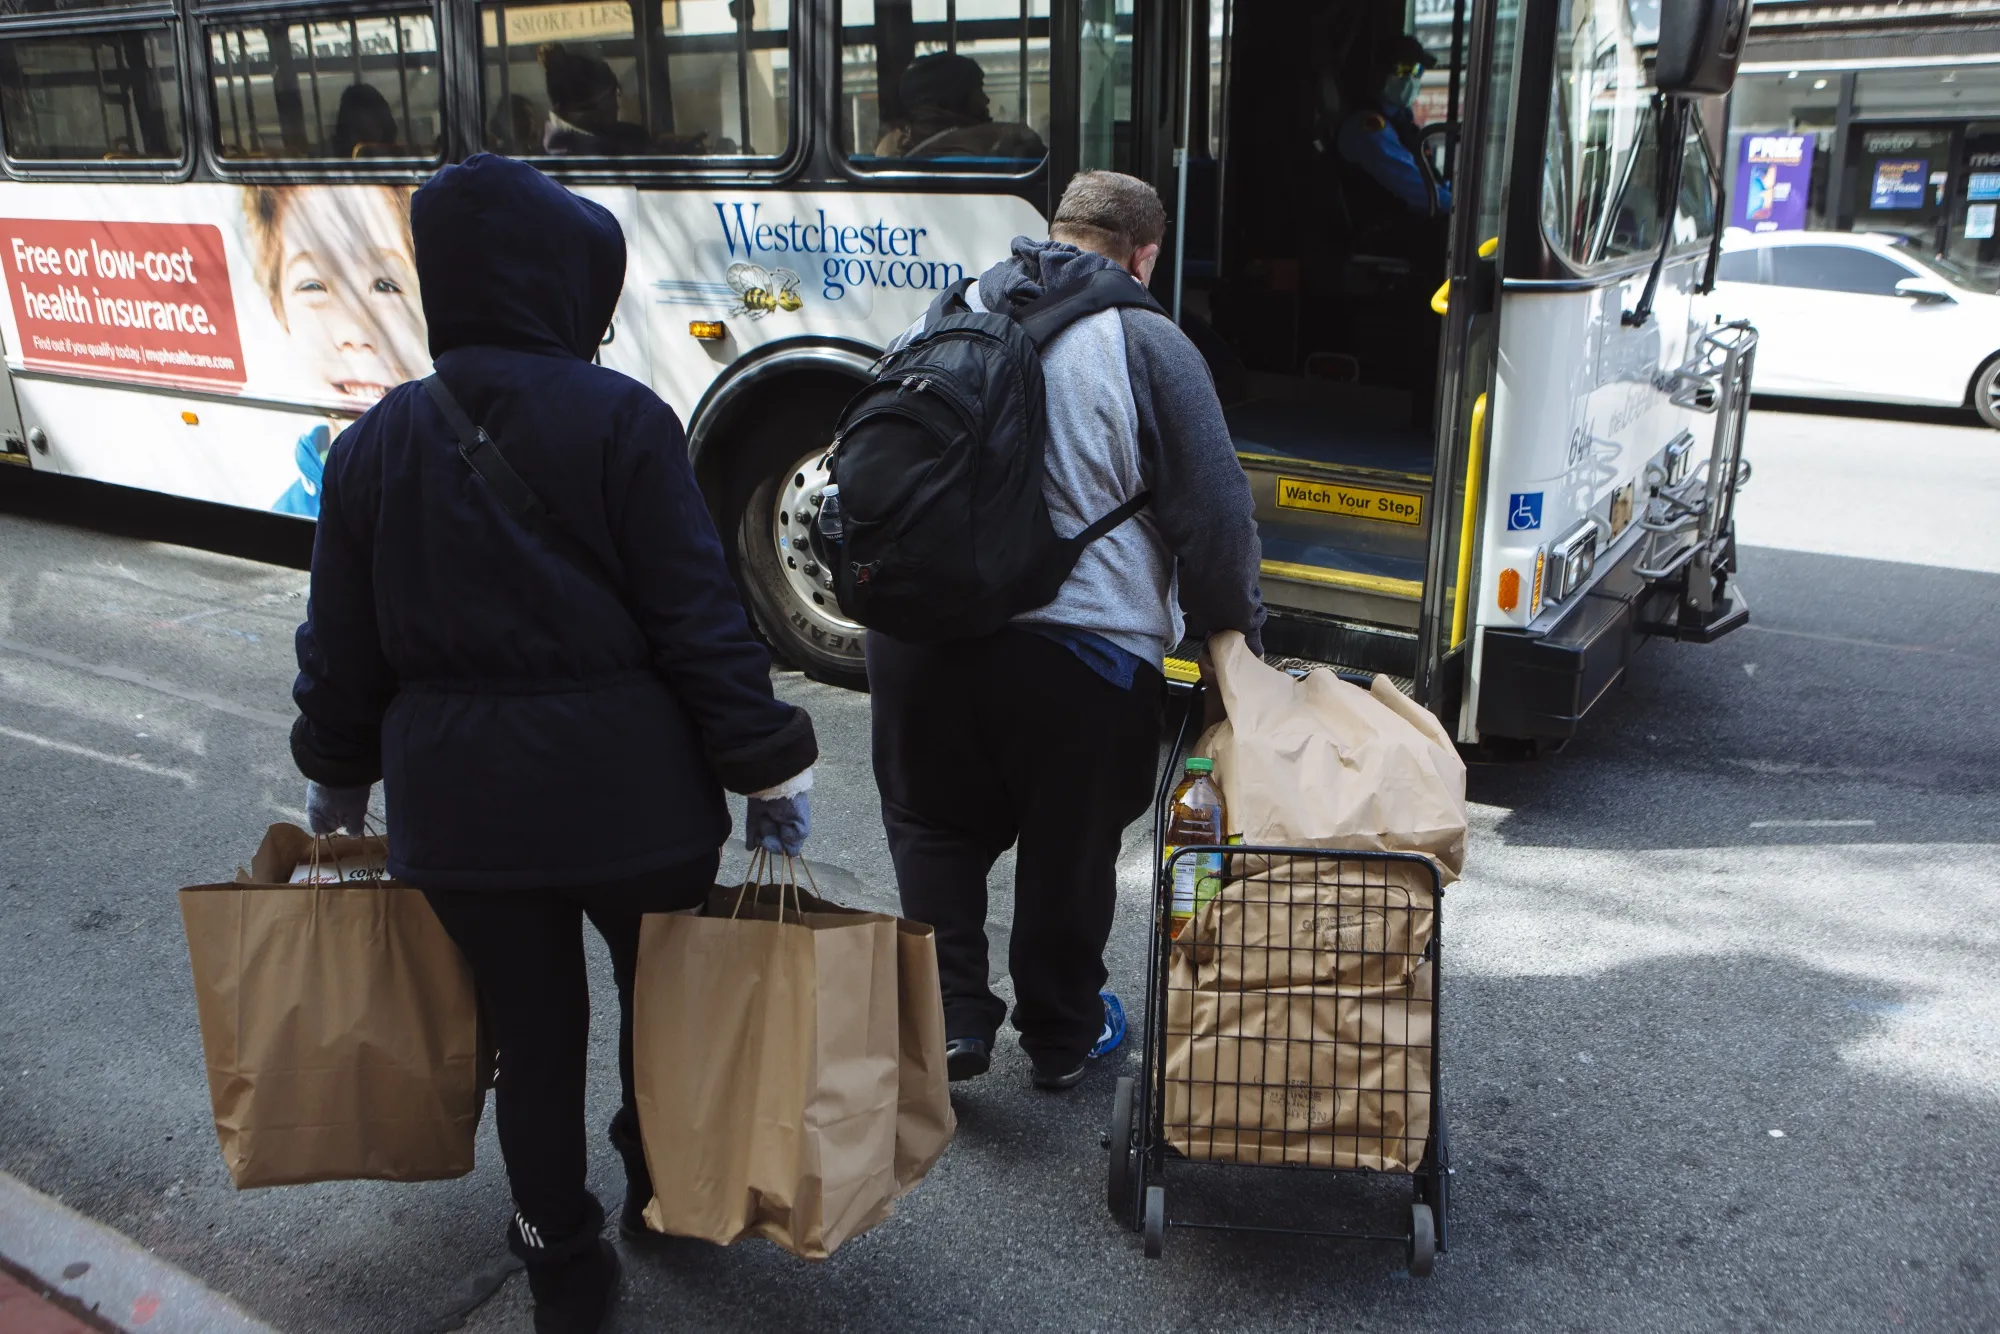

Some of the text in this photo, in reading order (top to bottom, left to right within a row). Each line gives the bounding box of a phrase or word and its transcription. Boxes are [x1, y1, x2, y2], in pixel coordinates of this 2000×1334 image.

[511, 11, 572, 36] SMOKE
[1748, 136, 1804, 159] FREE
[712, 202, 927, 258] Westchester
[11, 237, 198, 285] Free or low-cost
[822, 257, 963, 301] gov.com
[21, 281, 217, 336] health insurance.
[32, 335, 50, 350] Find
[50, 339, 64, 352] out
[72, 342, 89, 357] you
[88, 341, 116, 361] qualify
[115, 344, 142, 364] today.
[146, 347, 236, 371] mvphealthcare.com
[1567, 416, 1596, 467] 644
[1285, 486, 1415, 517] Watch Your Step
[349, 867, 386, 880] CORN
